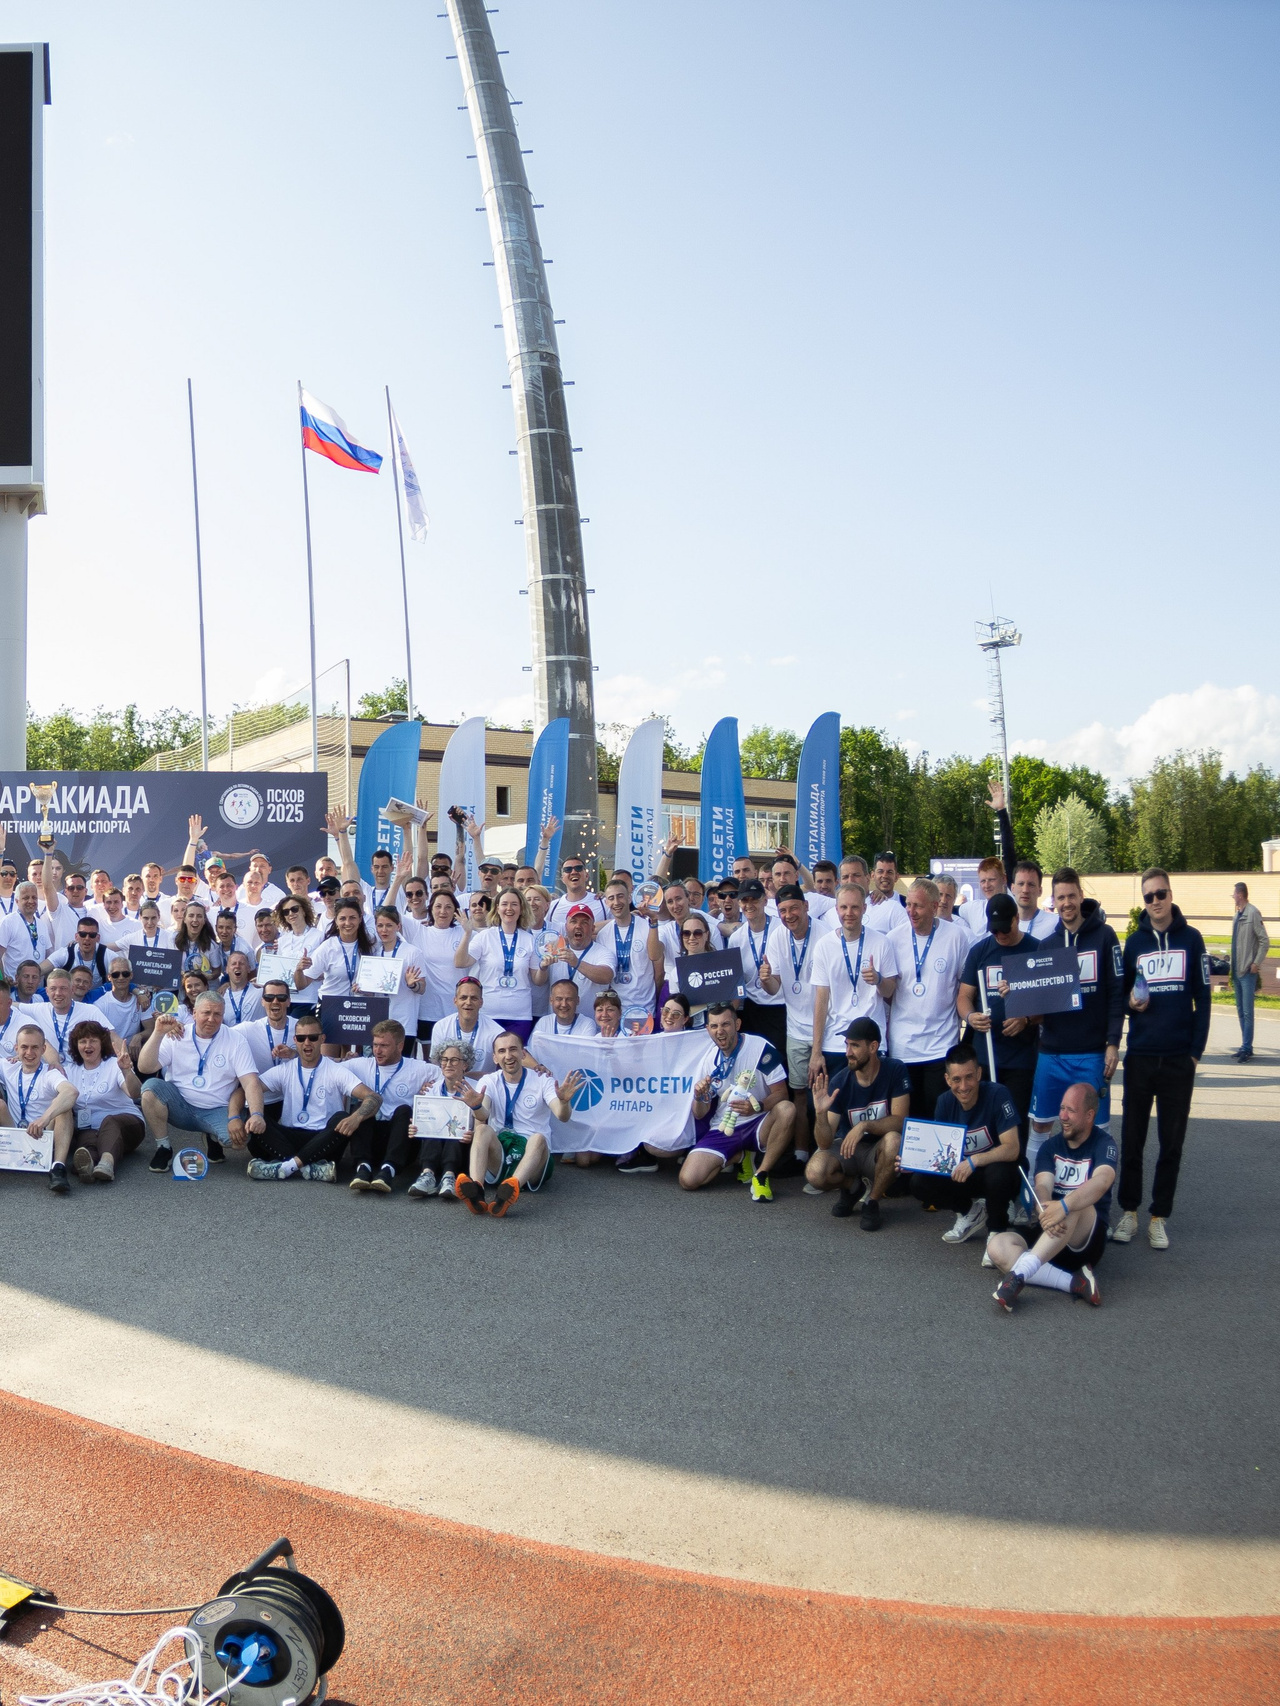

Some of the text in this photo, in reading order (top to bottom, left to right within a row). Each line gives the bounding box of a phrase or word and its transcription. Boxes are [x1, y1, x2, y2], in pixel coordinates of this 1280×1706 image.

[267, 789, 305, 803] ПСКОВ
[266, 803, 304, 823] 2025
[88, 820, 131, 834] СПОРТА
[809, 783, 820, 873] ПАРТАКИАДА
[631, 805, 644, 887] ОССЕТИ
[136, 961, 172, 970] АРХАНГЕЛЬСКИЙ
[143, 968, 163, 976] ФИЛИАЛ
[703, 969, 733, 980] РОССЕТИ
[1010, 975, 1064, 991] ПРОФМАСТЕРСТВО
[1065, 975, 1074, 983] ТВ
[161, 1002, 166, 1012] 1
[338, 1014, 371, 1023] ПСКОВСКИЙ
[342, 1023, 366, 1031] ФИЛИАЛ
[610, 1076, 693, 1094] РОССЕТИ
[609, 1100, 653, 1112] ЯНТАРЬ
[964, 1135, 978, 1150] РУ
[292, 1660, 308, 1693] СВЕТ
